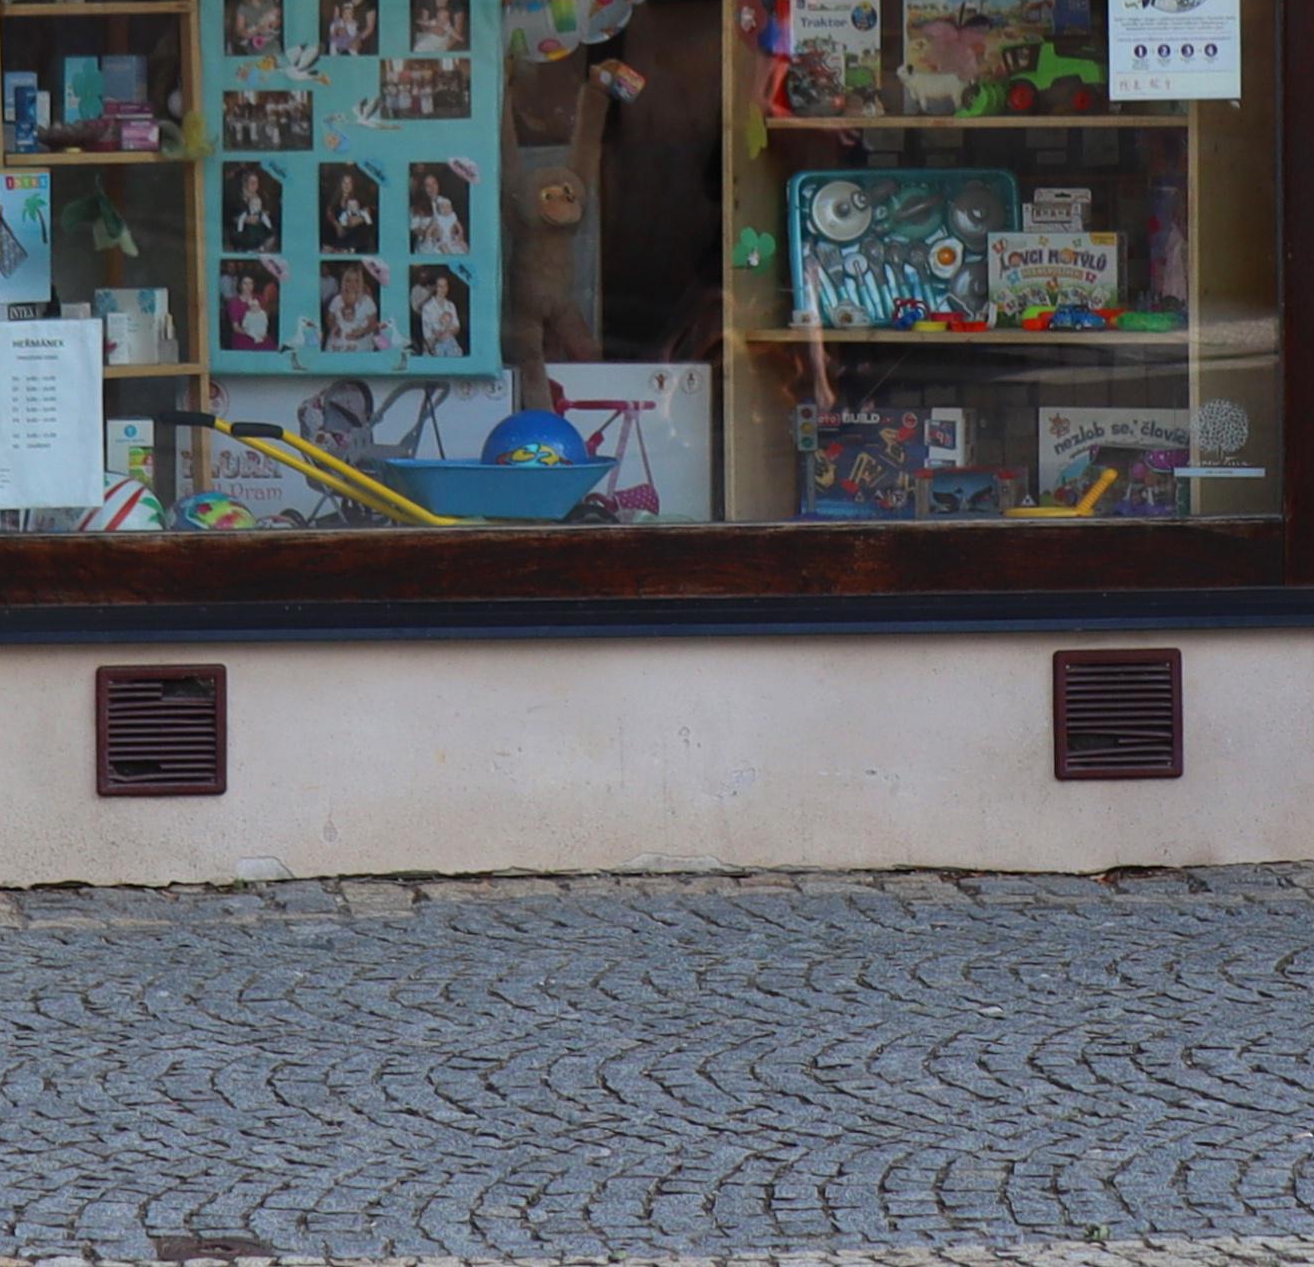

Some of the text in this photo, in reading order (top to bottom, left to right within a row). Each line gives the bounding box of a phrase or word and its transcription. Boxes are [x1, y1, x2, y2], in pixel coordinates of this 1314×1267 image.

[800, 17, 846, 28] Traktor
[1053, 421, 1105, 455] nezlob
[231, 484, 283, 501] Pram
